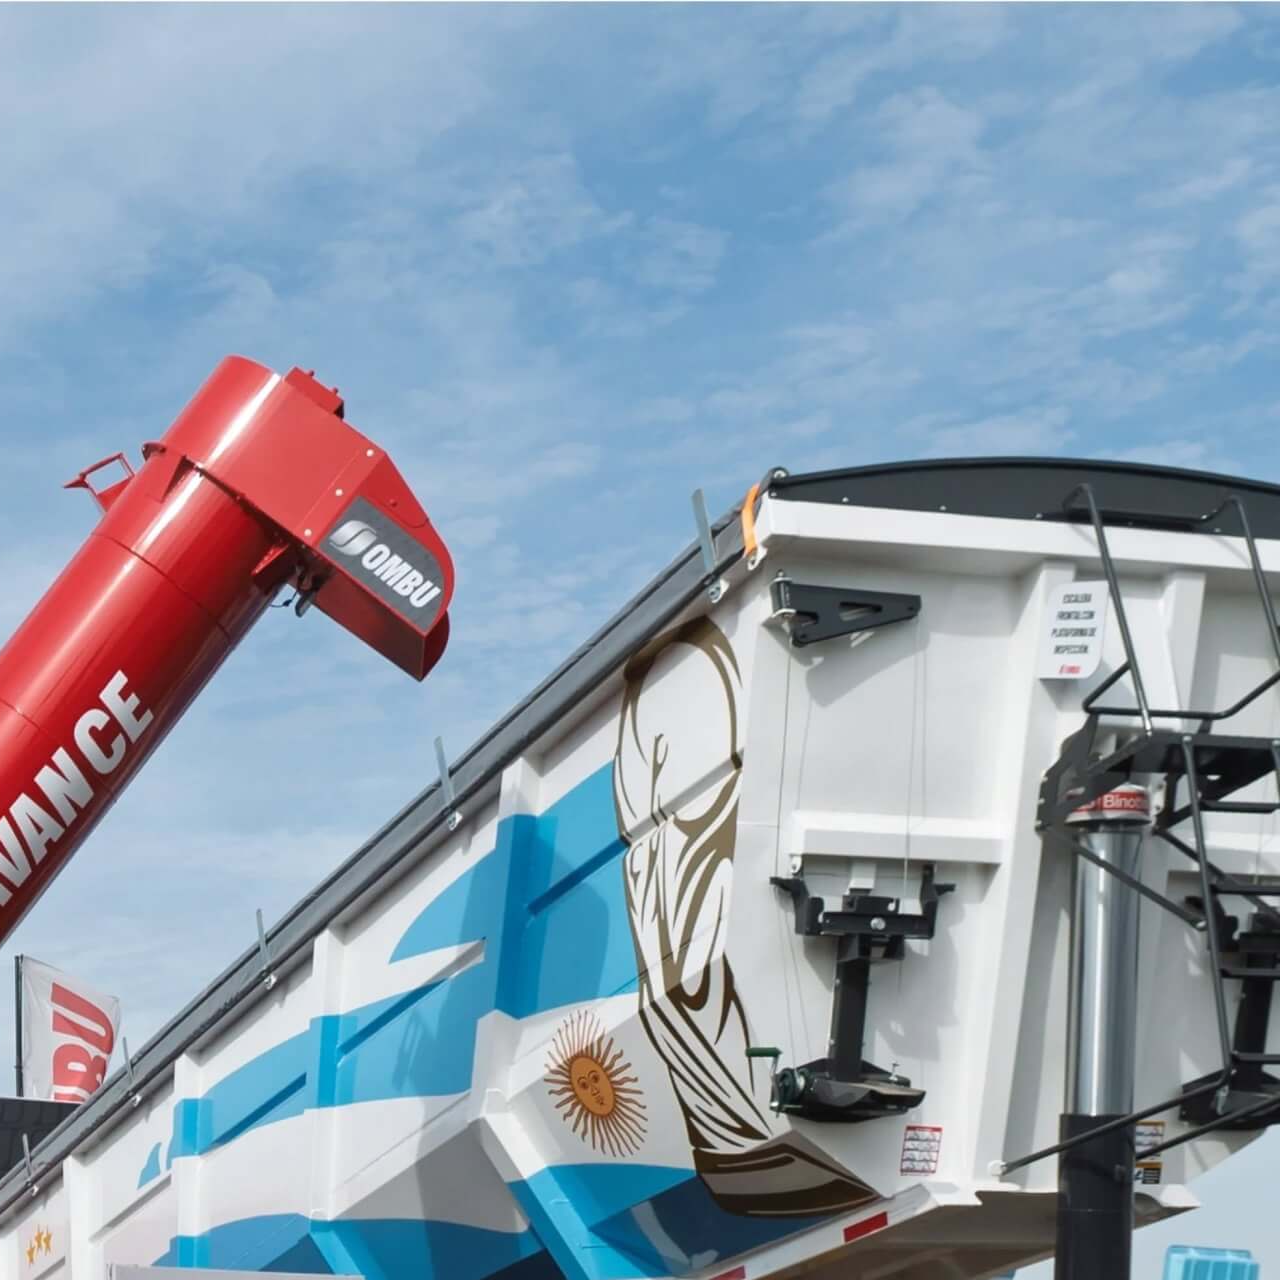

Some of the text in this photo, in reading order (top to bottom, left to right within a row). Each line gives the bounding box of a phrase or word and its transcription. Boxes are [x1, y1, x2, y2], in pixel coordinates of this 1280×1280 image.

[361, 543, 441, 608] OMBU
[1103, 794, 1150, 809] Bino
[50, 982, 114, 1103] BU
